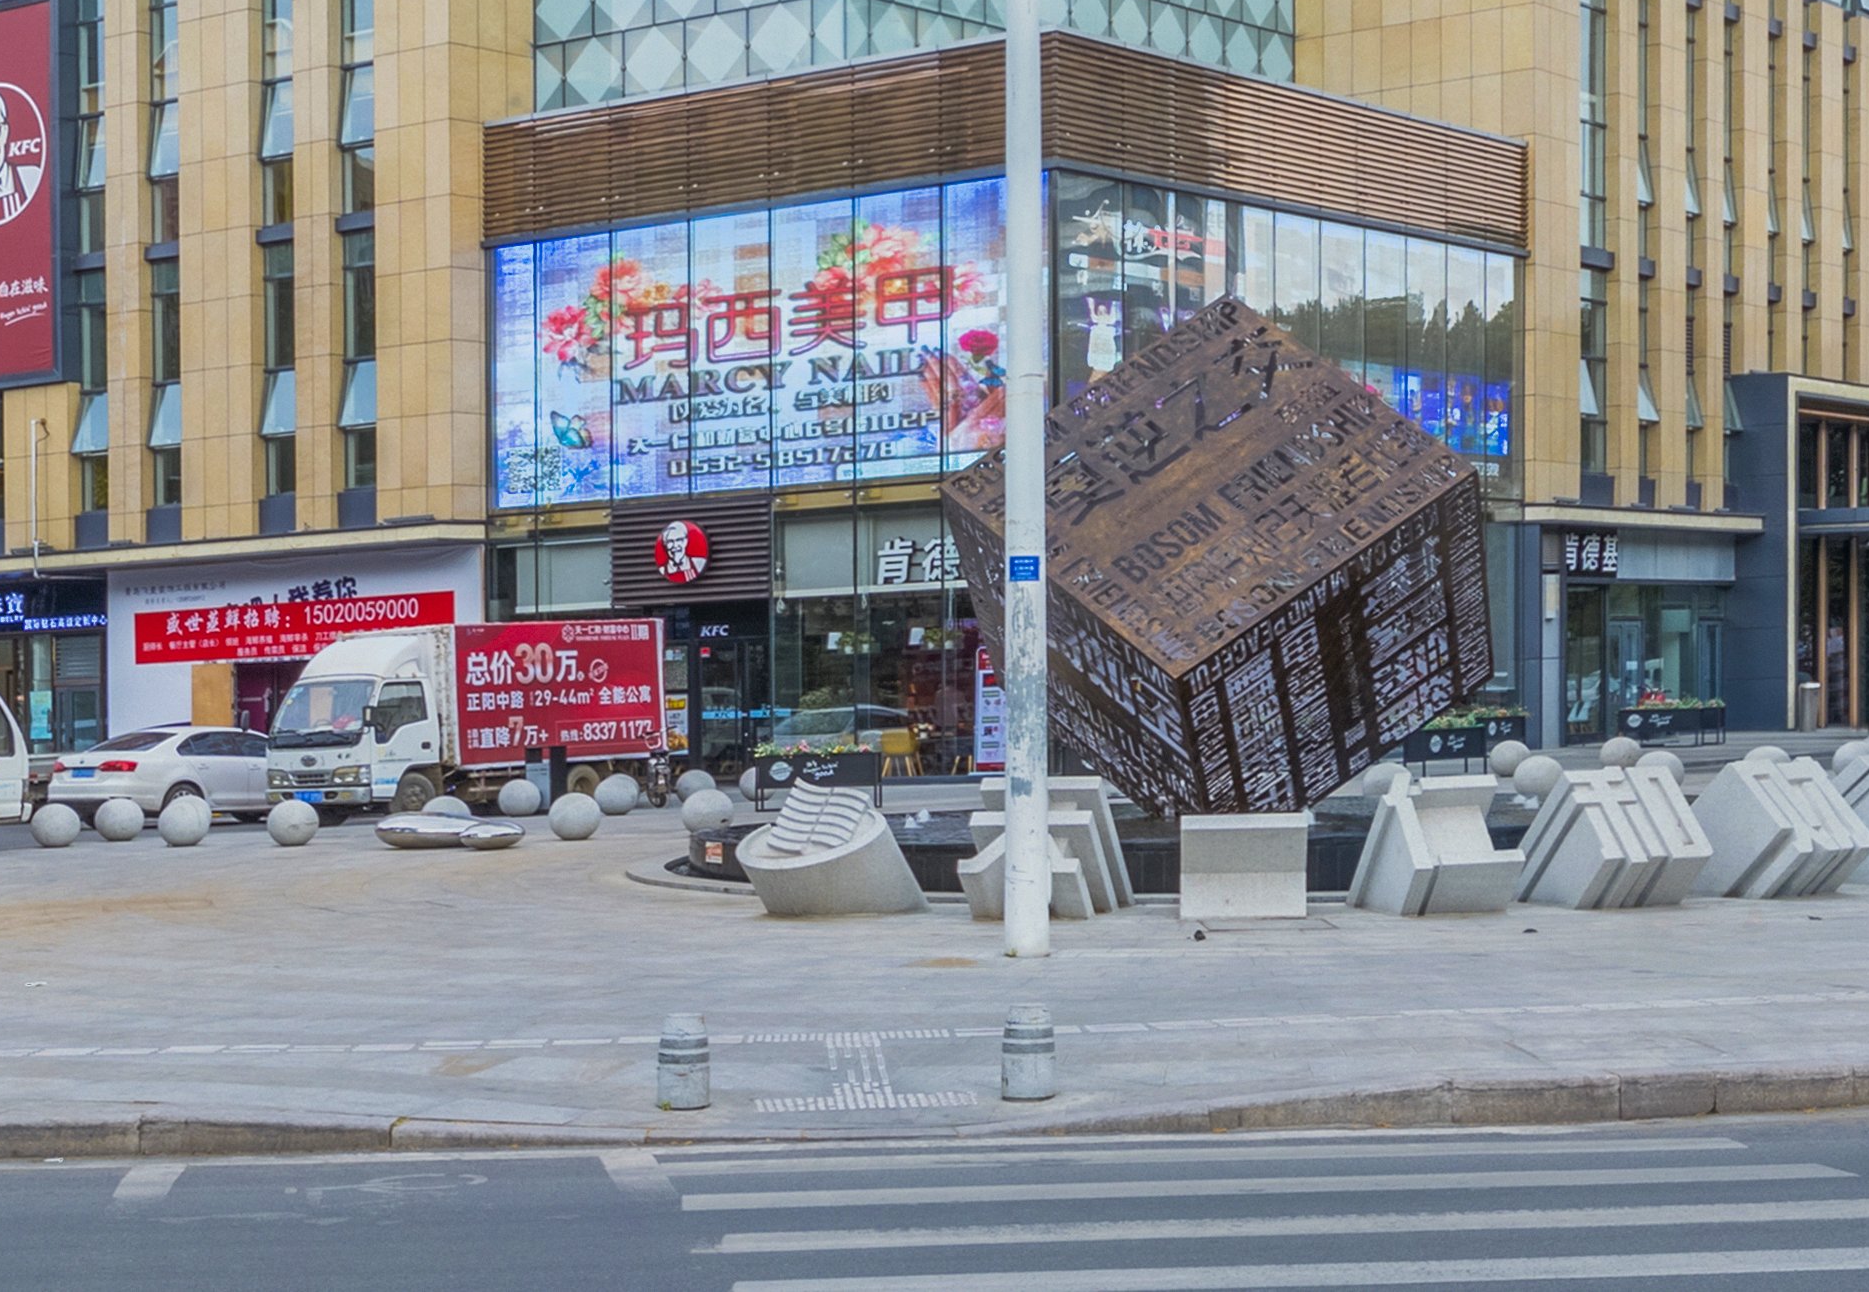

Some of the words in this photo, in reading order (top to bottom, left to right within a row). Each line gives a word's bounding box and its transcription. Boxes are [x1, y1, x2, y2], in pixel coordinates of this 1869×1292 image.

[8, 138, 41, 157] KFC
[623, 265, 955, 371] 玛西美甲
[617, 360, 793, 406] MARCY
[808, 345, 927, 387] NAIL
[1109, 500, 1228, 585] BOSOM
[1215, 391, 1387, 512] FRIENDSHIP
[877, 535, 961, 585] 肯德
[1565, 532, 1618, 572] 肯德基
[304, 598, 419, 625] 15020059000
[700, 624, 729, 637] KFC
[466, 691, 525, 712] 正阳中路
[598, 685, 652, 705] 全能公寓
